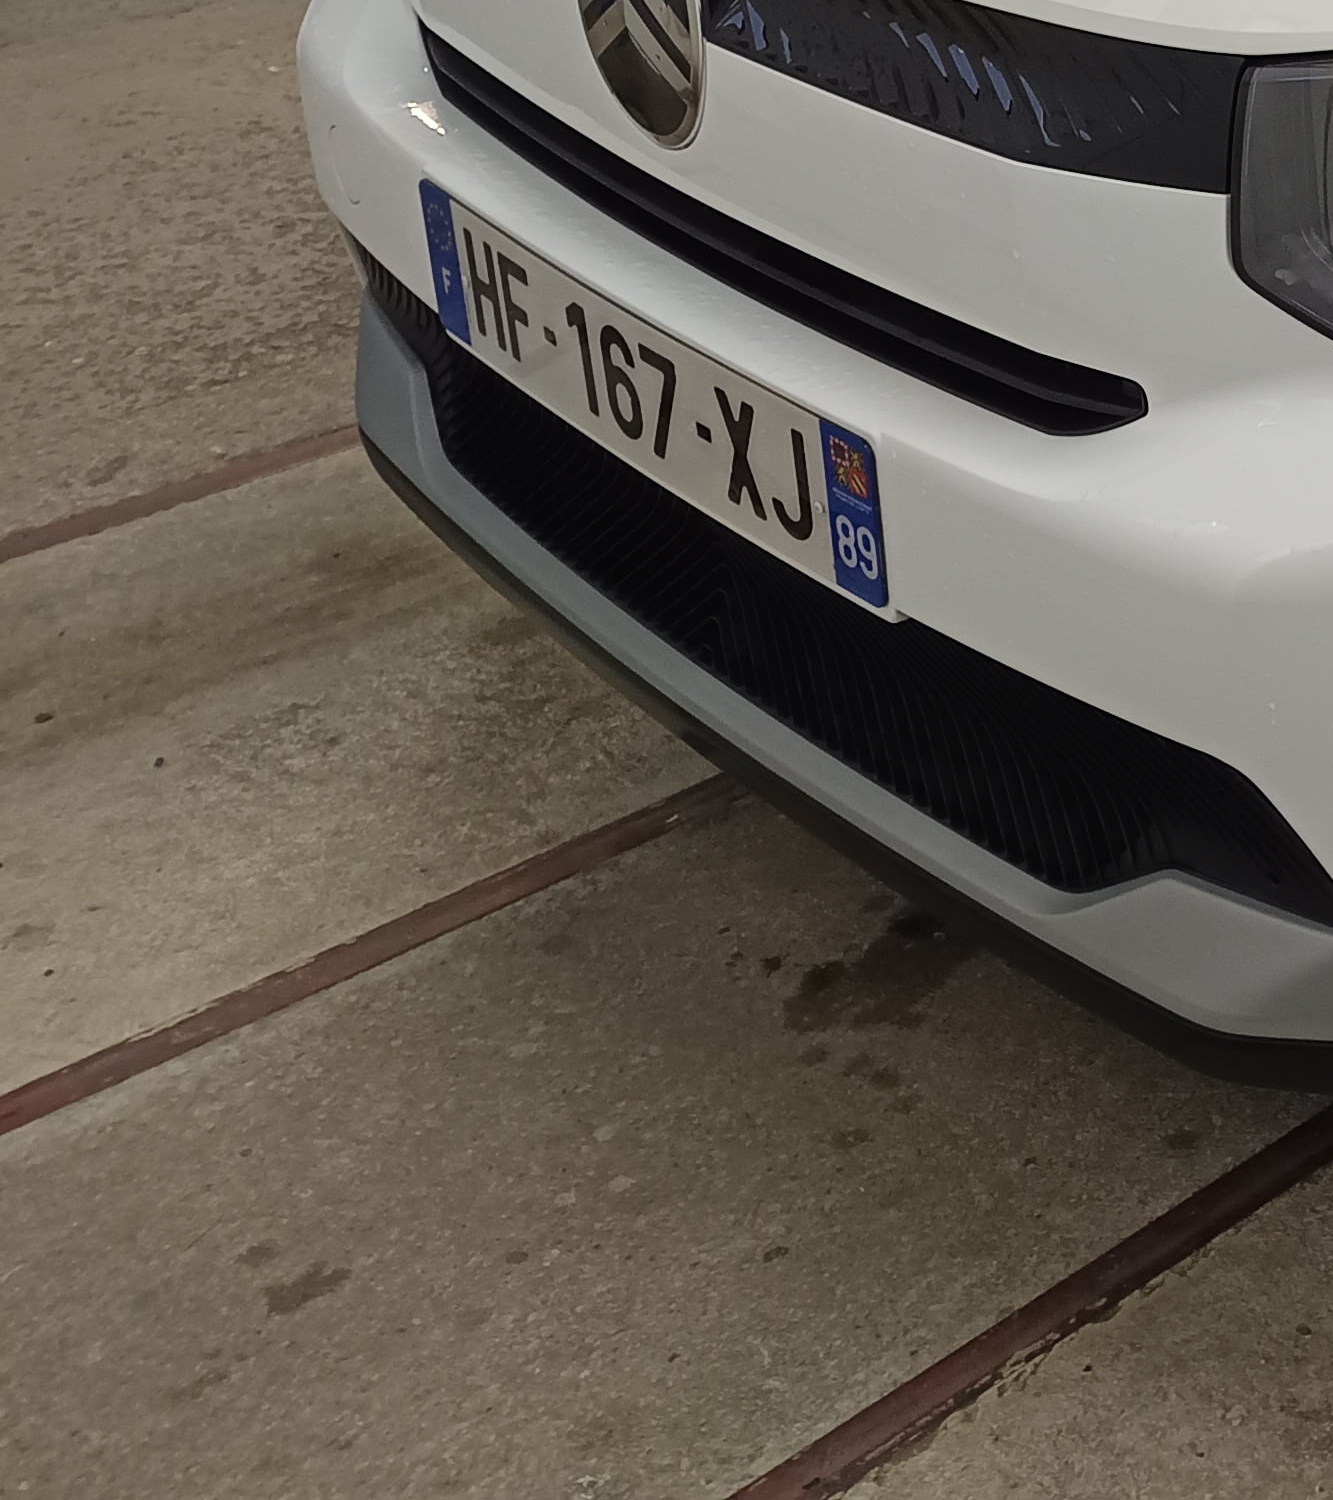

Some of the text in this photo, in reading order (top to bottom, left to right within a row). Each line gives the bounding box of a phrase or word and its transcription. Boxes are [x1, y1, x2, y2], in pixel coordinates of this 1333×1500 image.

[441, 266, 451, 294] F
[463, 227, 813, 541] HF-167-XJ
[835, 514, 879, 580] 89
